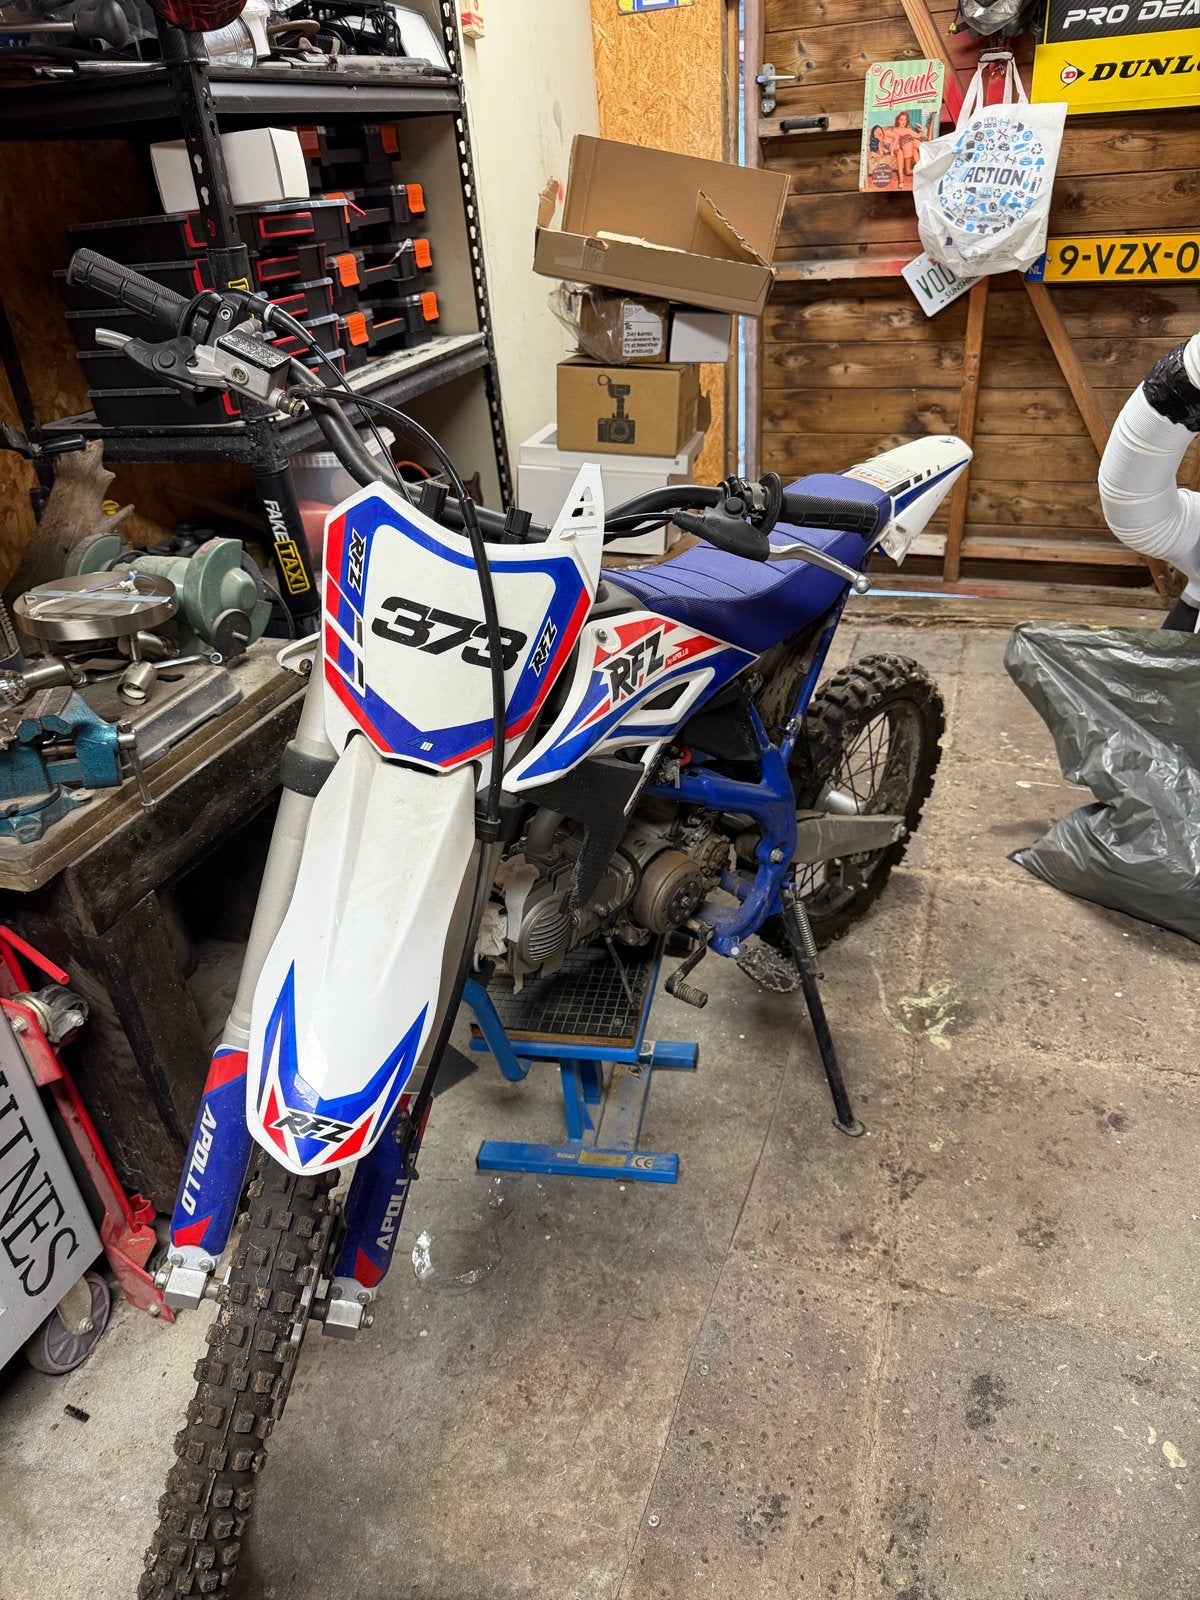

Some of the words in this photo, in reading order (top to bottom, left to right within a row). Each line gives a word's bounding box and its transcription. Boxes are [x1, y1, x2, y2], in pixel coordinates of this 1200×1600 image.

[1062, 4, 1130, 29] PRO
[875, 61, 938, 108] Spank
[963, 166, 1026, 187] ACTION
[944, 275, 980, 299] SUNSHIN
[1028, 265, 1042, 275] NL
[263, 499, 290, 542] FAKE
[280, 544, 306, 590] TAXI
[349, 529, 366, 595] RFZ
[371, 596, 528, 671] 373
[529, 617, 557, 677] RFZ
[603, 630, 665, 703] RFZ
[274, 1110, 354, 1143] RFZ
[0, 1070, 80, 1297] INES
[182, 1102, 217, 1216] APOLLO
